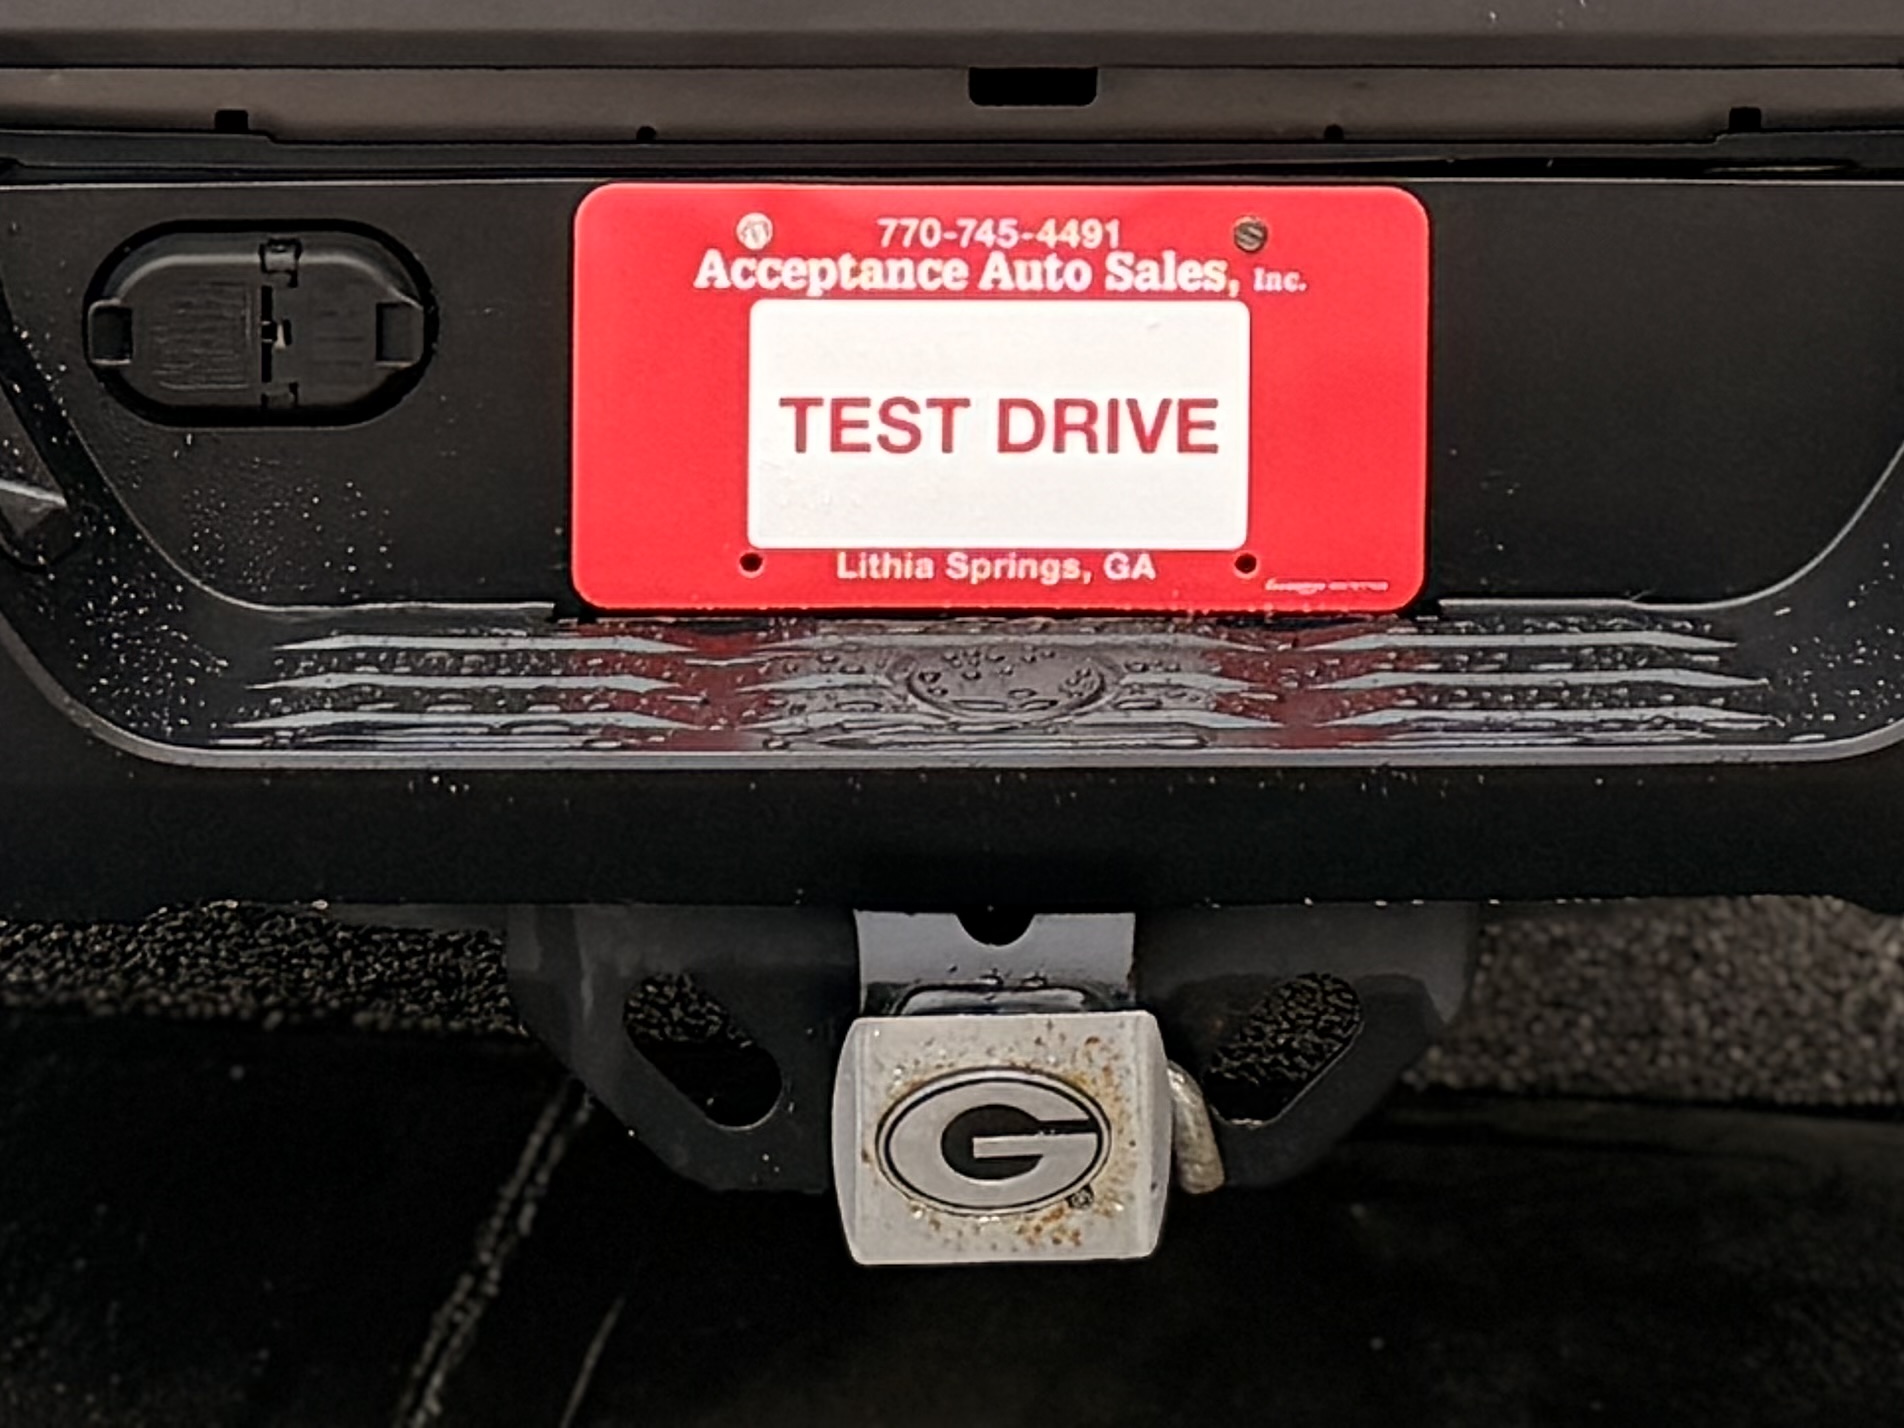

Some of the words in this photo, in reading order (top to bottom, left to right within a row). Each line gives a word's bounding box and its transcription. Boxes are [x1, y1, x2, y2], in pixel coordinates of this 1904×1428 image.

[876, 217, 1121, 250] 770-745-4491
[693, 249, 968, 297] Acceptance
[978, 251, 1094, 291] Auto
[1104, 252, 1241, 298] Sales,
[1252, 266, 1308, 293] Inc.
[780, 397, 971, 455] TEST
[998, 397, 1220, 455] DRIVE
[837, 550, 935, 581] Lithia
[946, 550, 1093, 586] Springs,
[1103, 551, 1157, 582] GA
